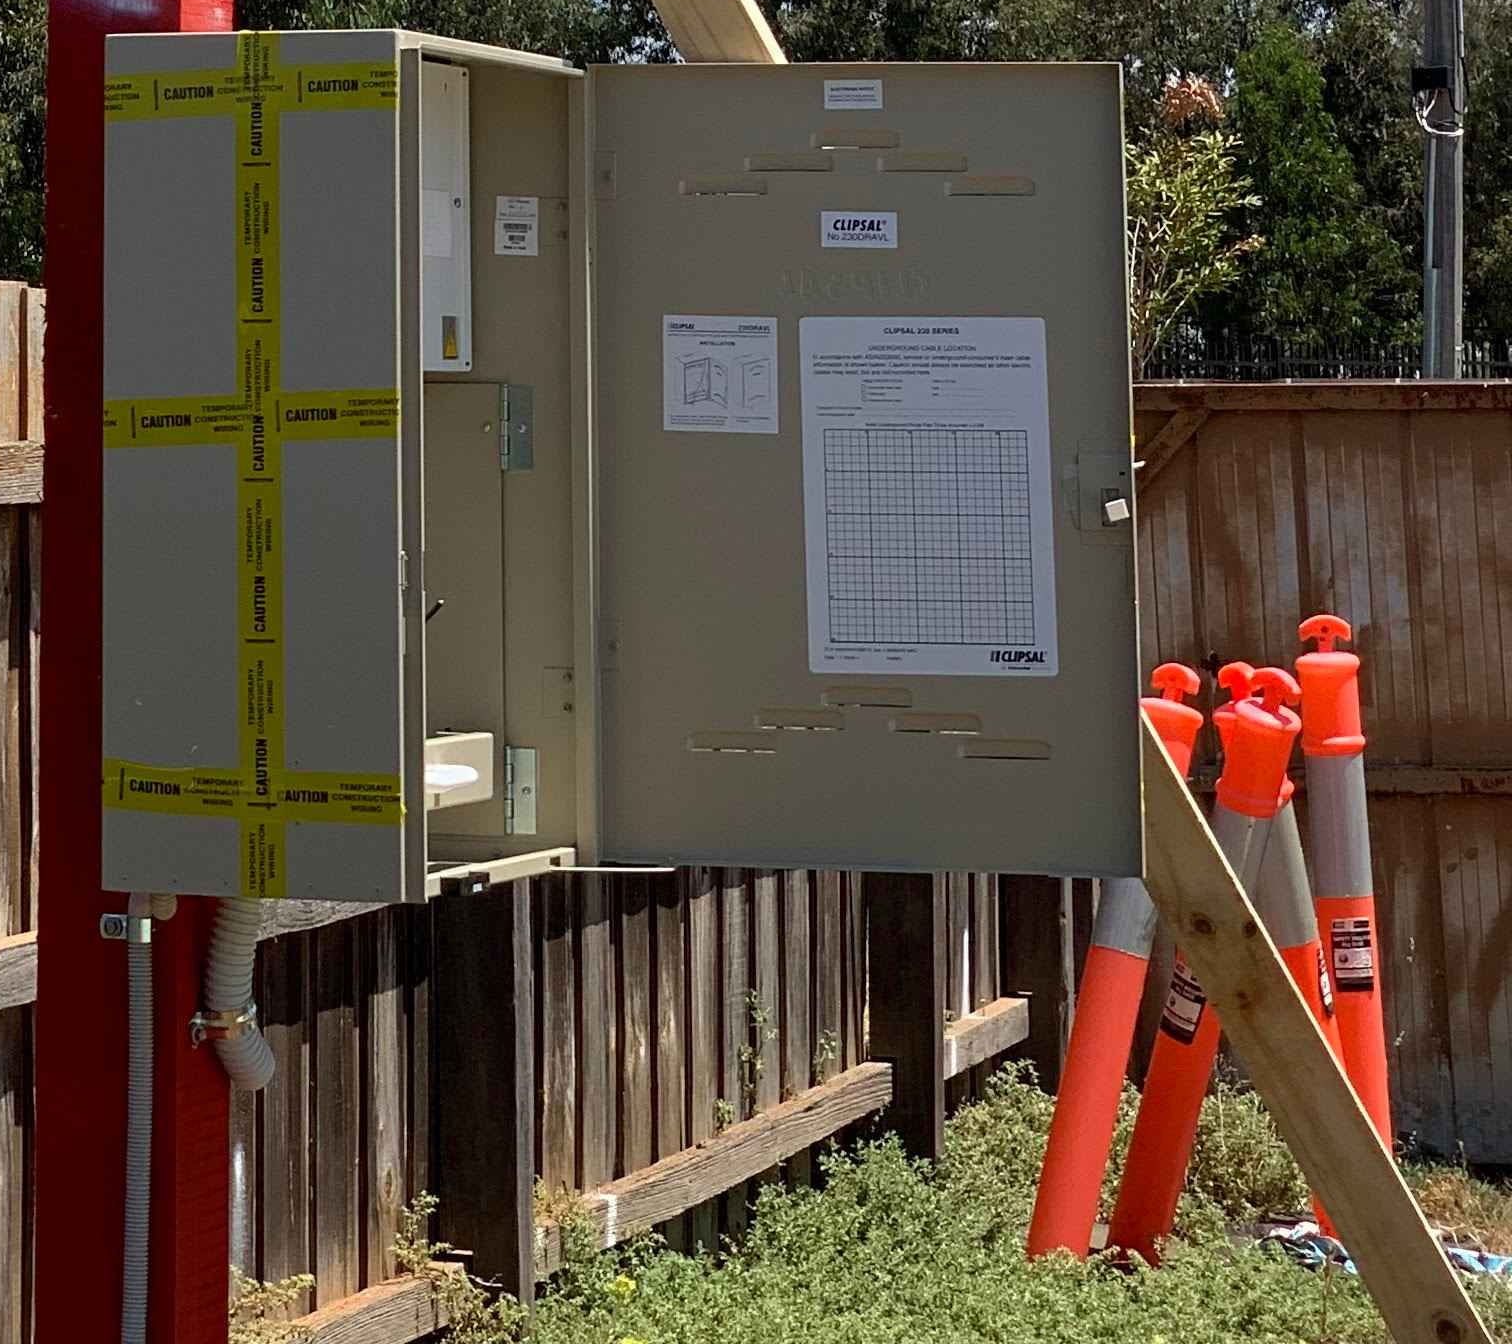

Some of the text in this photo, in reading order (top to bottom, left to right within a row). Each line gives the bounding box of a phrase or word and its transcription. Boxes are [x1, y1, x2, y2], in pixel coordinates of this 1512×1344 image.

[163, 86, 214, 101] CAUTION
[307, 80, 360, 93] CAUTION
[251, 102, 263, 156] CAUTION
[833, 219, 882, 231] CLIPSAL
[251, 258, 264, 312] CAUTION
[141, 414, 192, 429] CAUTION
[285, 407, 337, 422] CAUTION
[252, 416, 265, 472] CAUTION
[254, 575, 266, 632] CAUTION
[1001, 650, 1045, 663] CLIPSAL
[256, 738, 267, 796] CAUTION
[130, 779, 181, 796] CAUTION
